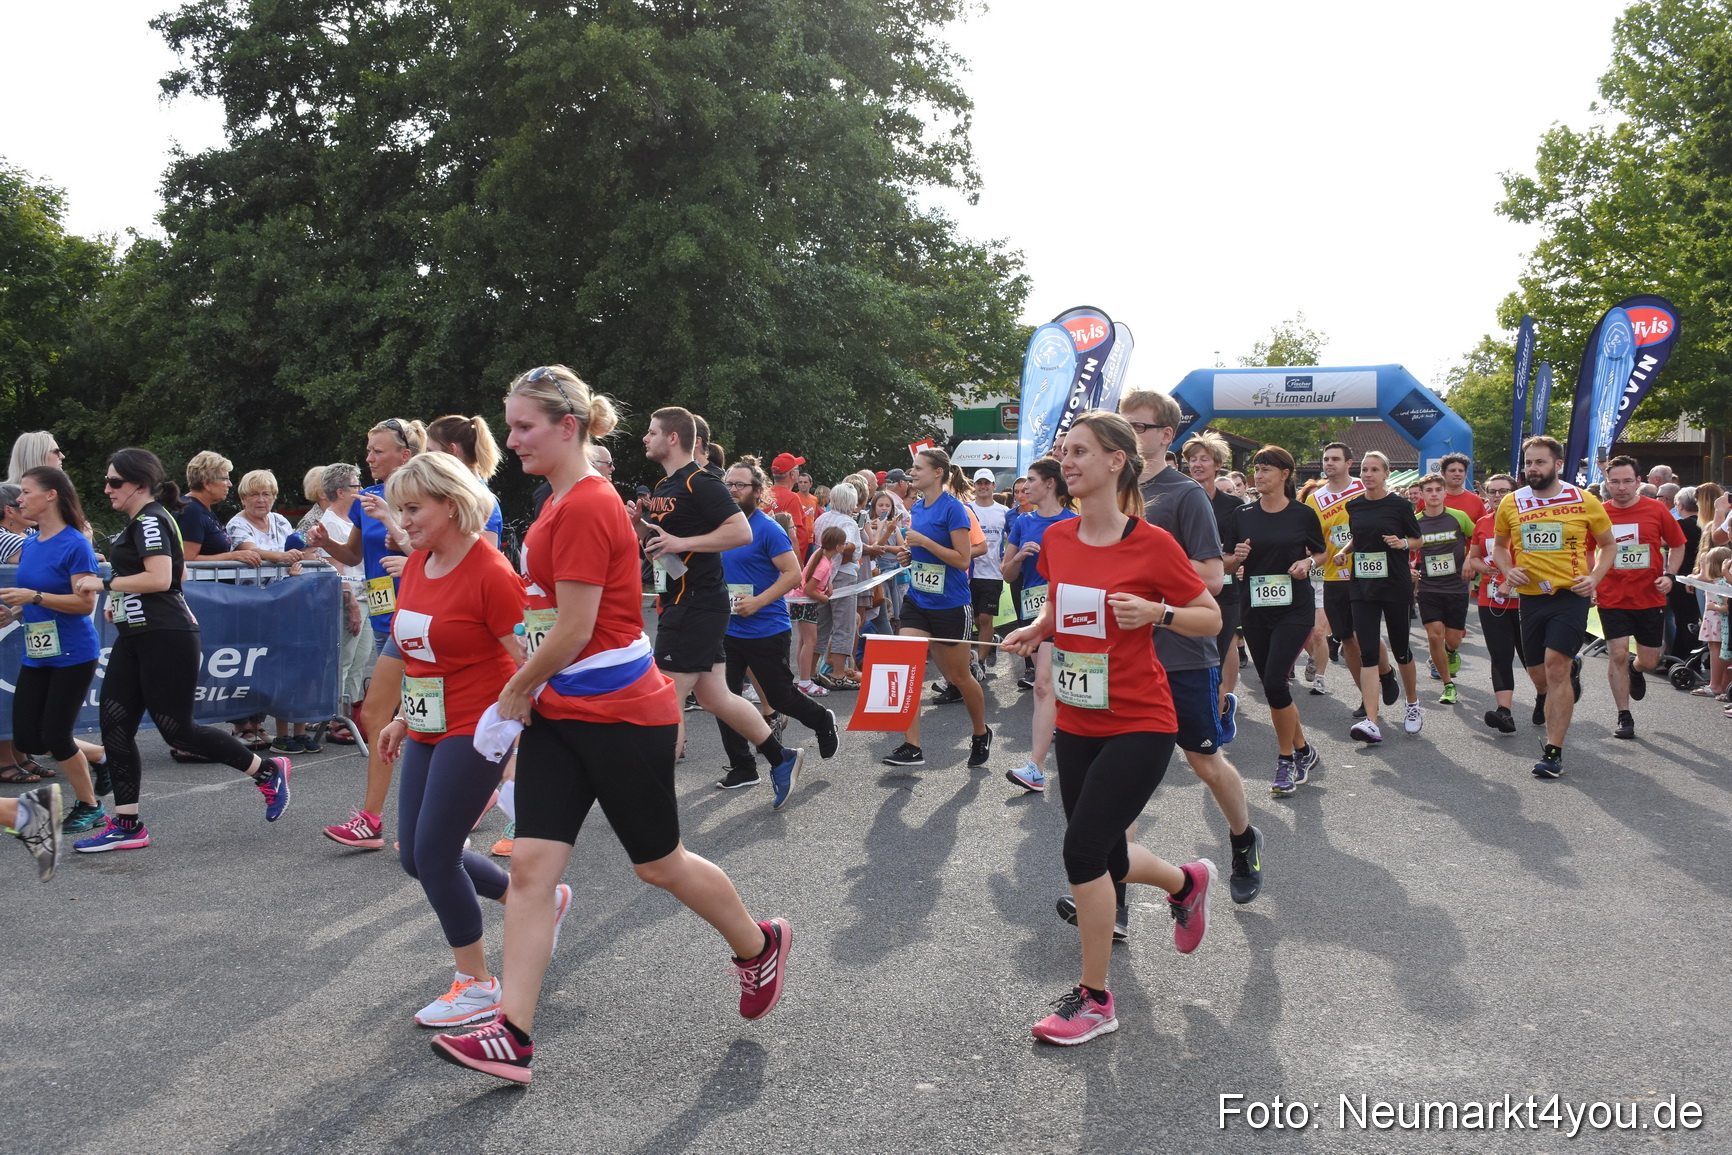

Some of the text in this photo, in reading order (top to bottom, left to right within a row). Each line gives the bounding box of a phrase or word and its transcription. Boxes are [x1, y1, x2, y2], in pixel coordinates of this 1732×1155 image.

[1631, 317, 1668, 338] rvis
[1615, 354, 1658, 423] OVIN
[1275, 391, 1336, 403] firmenlauf
[1322, 505, 1344, 520] MAX
[1519, 506, 1586, 523] MAX BÖGL
[1526, 533, 1557, 543] 1620
[1622, 553, 1642, 563] 507
[1358, 561, 1383, 571] 1868
[1432, 561, 1449, 571] 318
[914, 571, 939, 585] 1142
[368, 589, 388, 605] 1131
[1255, 585, 1286, 598] 1866
[1024, 596, 1046, 611] 1139
[26, 634, 52, 648] 1132
[1058, 669, 1088, 693] 471
[403, 694, 428, 717] 534
[902, 695, 912, 714] DEHN
